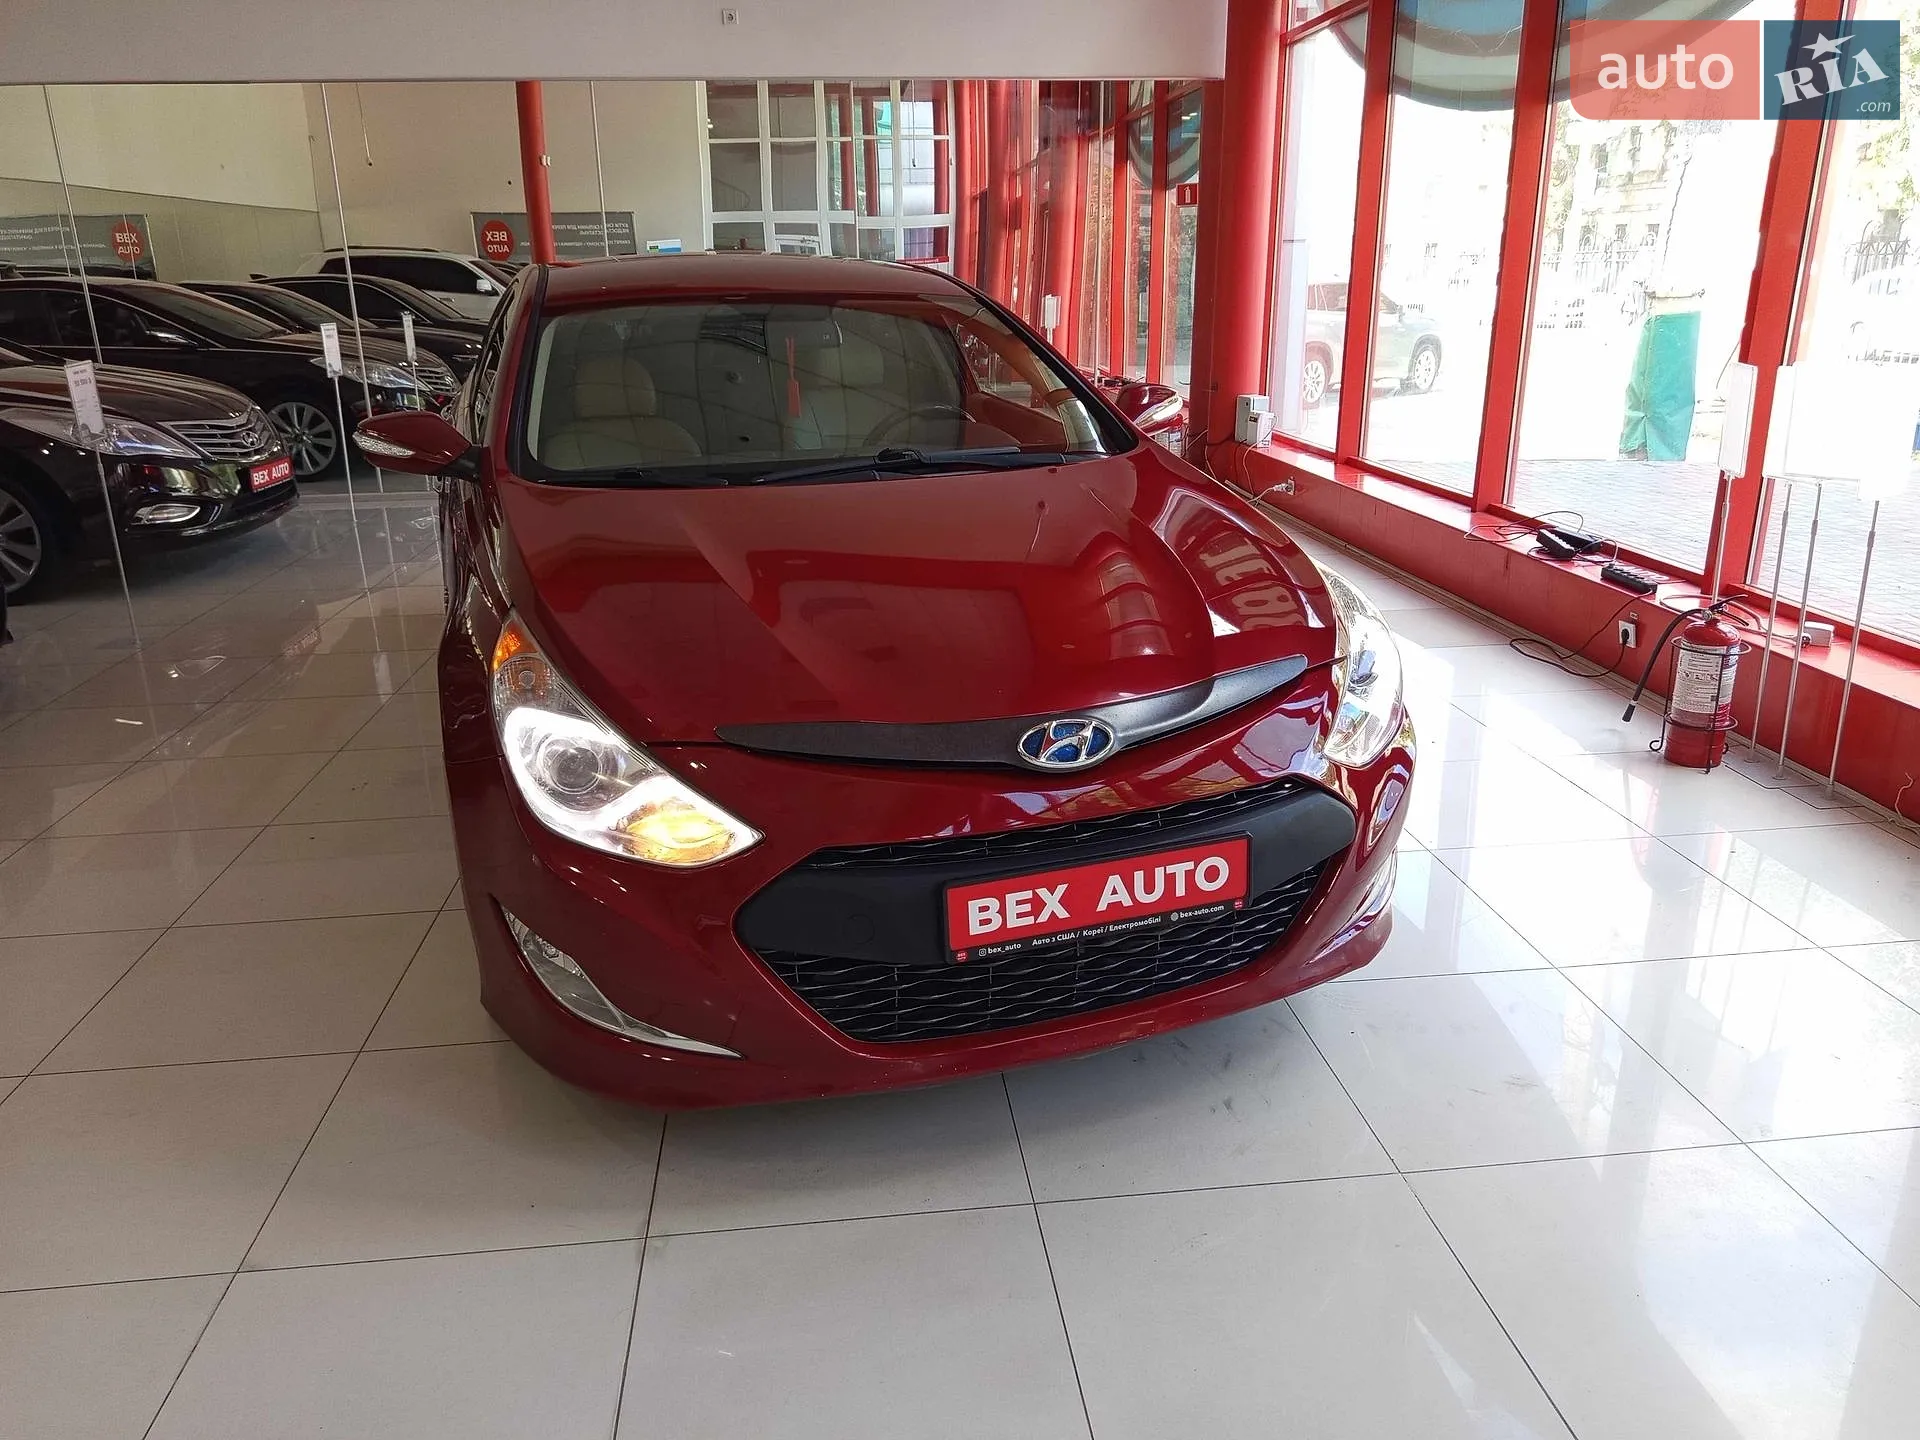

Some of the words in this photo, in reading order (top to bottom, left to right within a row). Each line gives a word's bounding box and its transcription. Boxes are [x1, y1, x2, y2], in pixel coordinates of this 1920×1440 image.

[253, 469, 270, 485] BEX
[272, 462, 289, 479] AUTO
[967, 883, 1071, 935] BEX
[1095, 856, 1230, 912] AUTO
[1180, 905, 1225, 918] bex-auto.com
[1057, 932, 1076, 941] США
[1109, 915, 1161, 932] Електромобілі
[987, 943, 1022, 954] bex_auto
